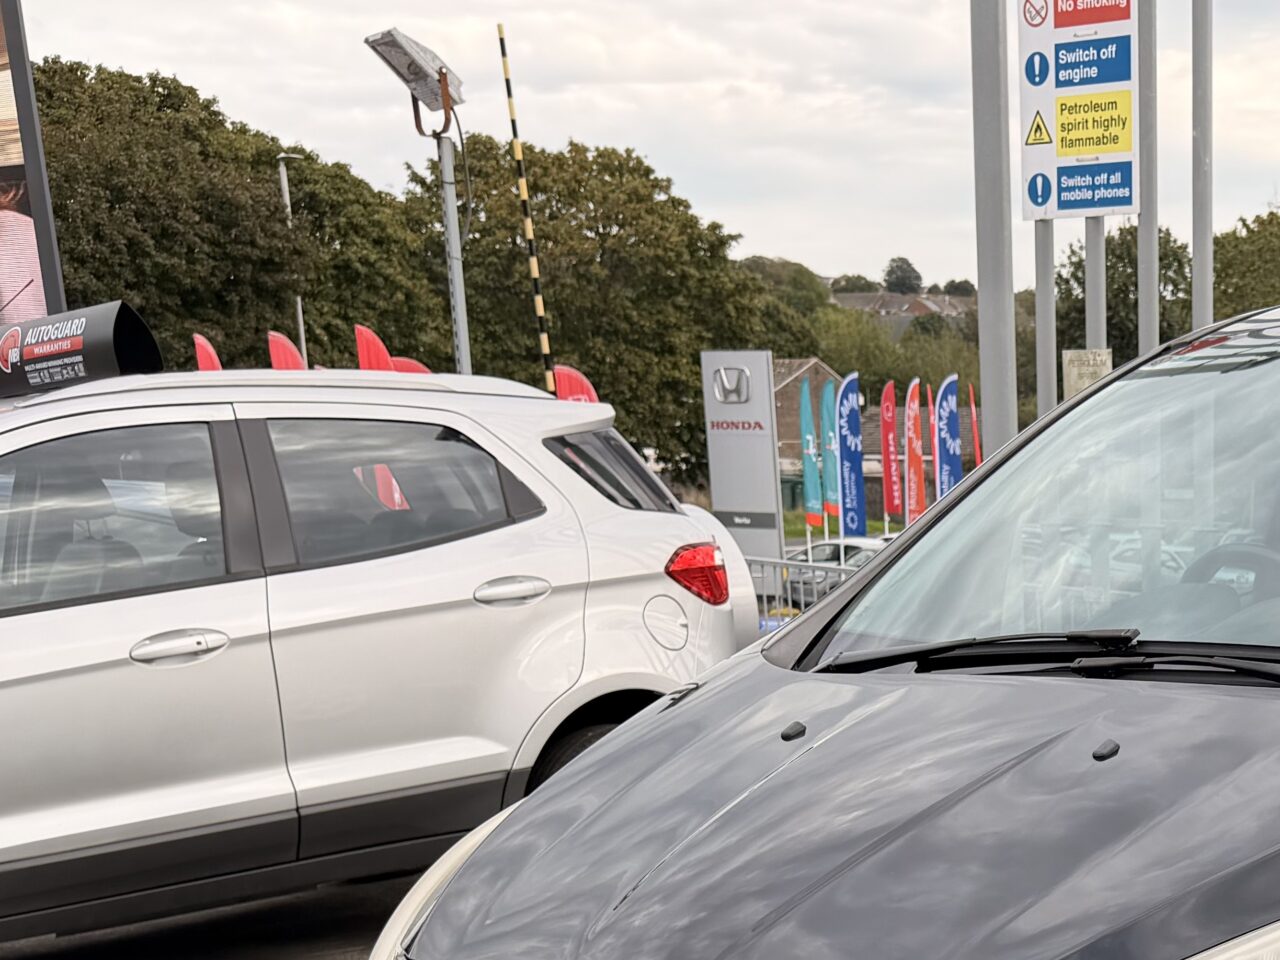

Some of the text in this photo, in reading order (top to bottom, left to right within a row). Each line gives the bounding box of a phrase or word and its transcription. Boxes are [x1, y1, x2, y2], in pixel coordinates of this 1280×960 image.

[1058, 0, 1074, 12] No
[1058, 44, 1116, 65] Switch off
[1058, 66, 1098, 82] engine
[1060, 100, 1118, 116] Petroleum
[1060, 114, 1128, 135] spirit highly
[1060, 132, 1120, 149] flammable
[1060, 172, 1121, 188] Switch off all
[1060, 186, 1130, 202] mobile phones
[24, 317, 86, 346] AUTOGUARD
[711, 421, 764, 431] HONDA
[888, 432, 901, 506] HONDA
